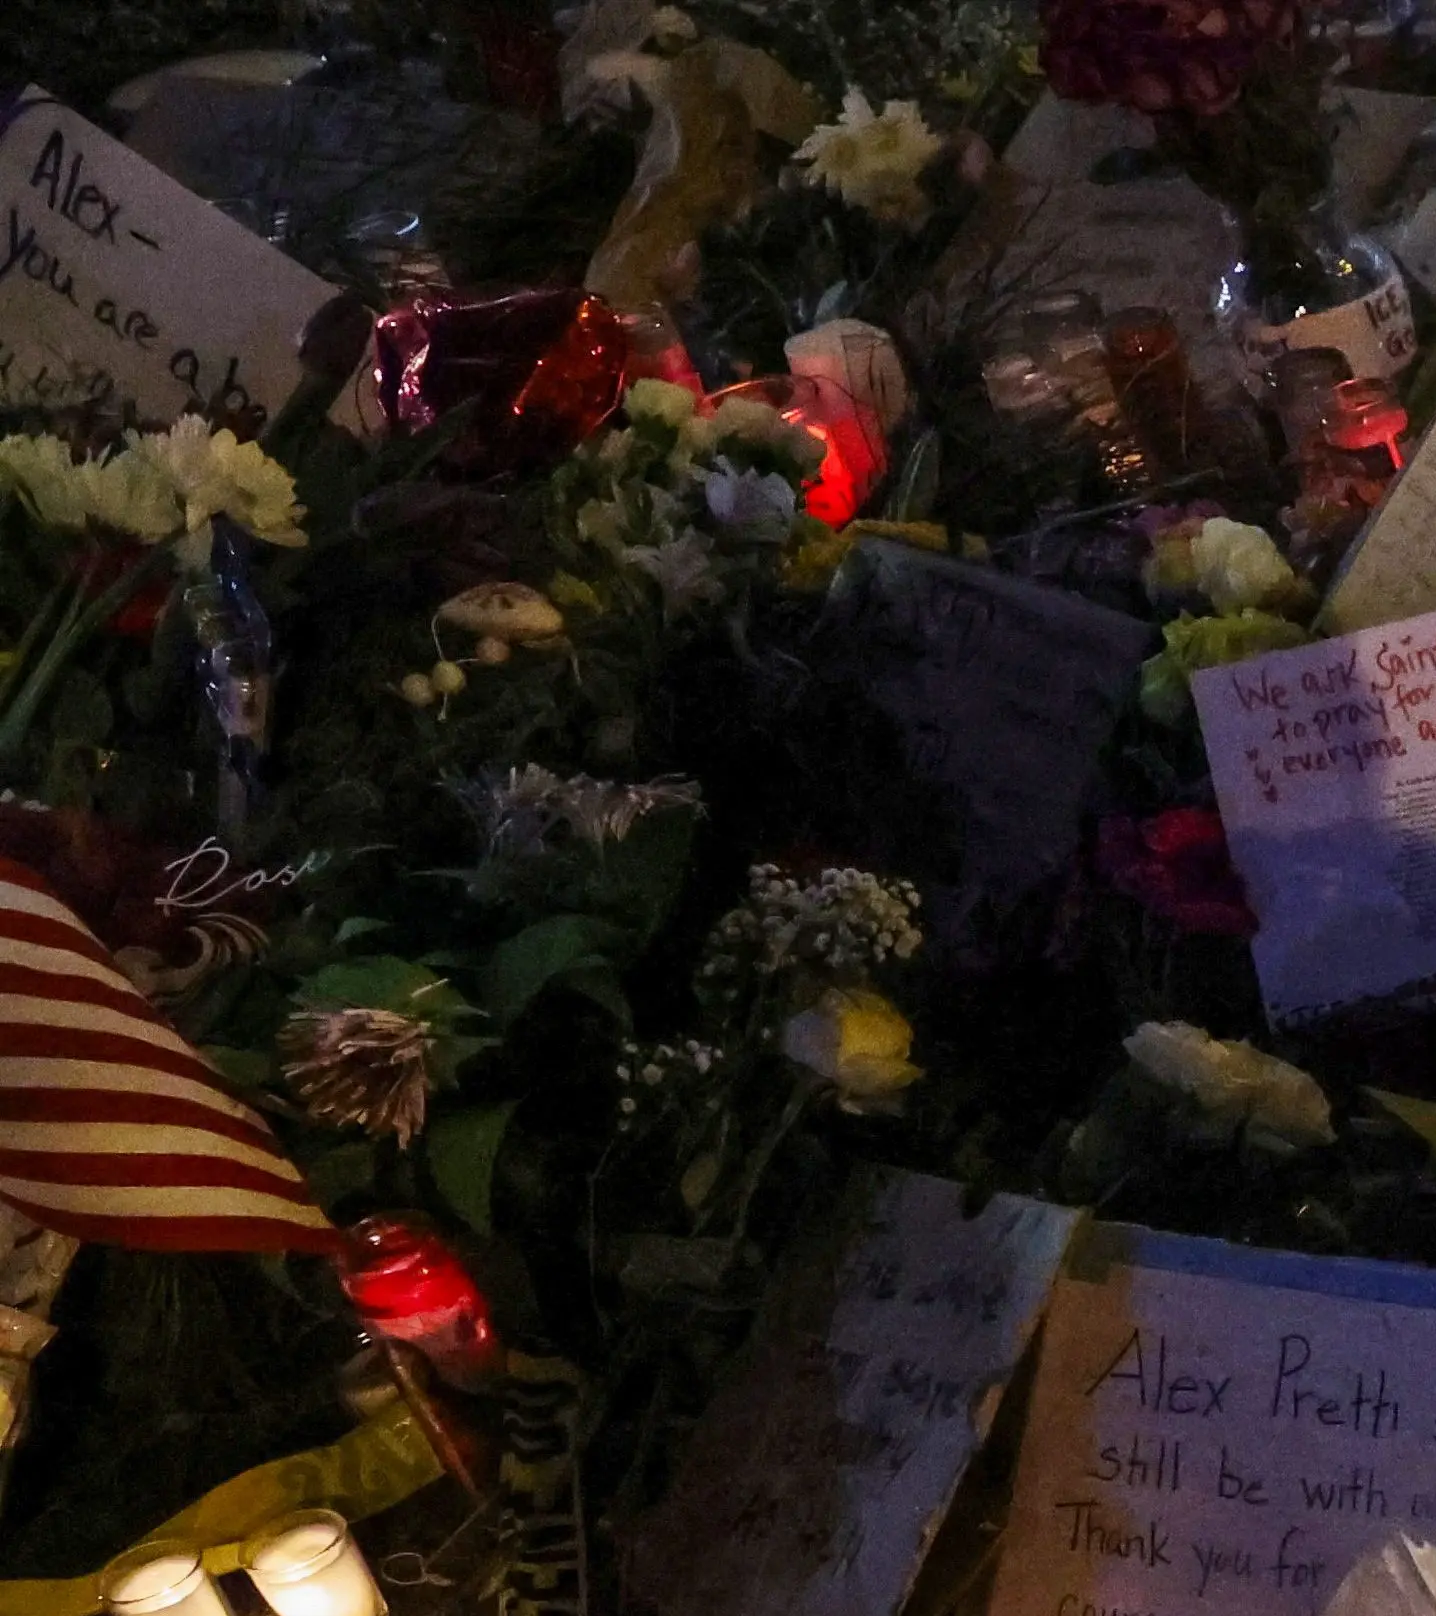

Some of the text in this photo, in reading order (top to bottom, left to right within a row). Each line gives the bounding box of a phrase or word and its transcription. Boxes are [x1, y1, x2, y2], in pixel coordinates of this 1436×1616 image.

[94, 299, 158, 350] are
[1234, 672, 1289, 715] We
[1272, 716, 1308, 745] to
[1311, 696, 1391, 752] pray
[1393, 676, 1434, 718] for
[1282, 735, 1408, 777] everyone
[1085, 1328, 1231, 1415] Alex
[1272, 1333, 1400, 1438] Pretti
[1088, 1436, 1181, 1492] still
[1217, 1447, 1271, 1507] be
[1301, 1470, 1387, 1518] with
[1055, 1501, 1325, 1598] Thank you for
